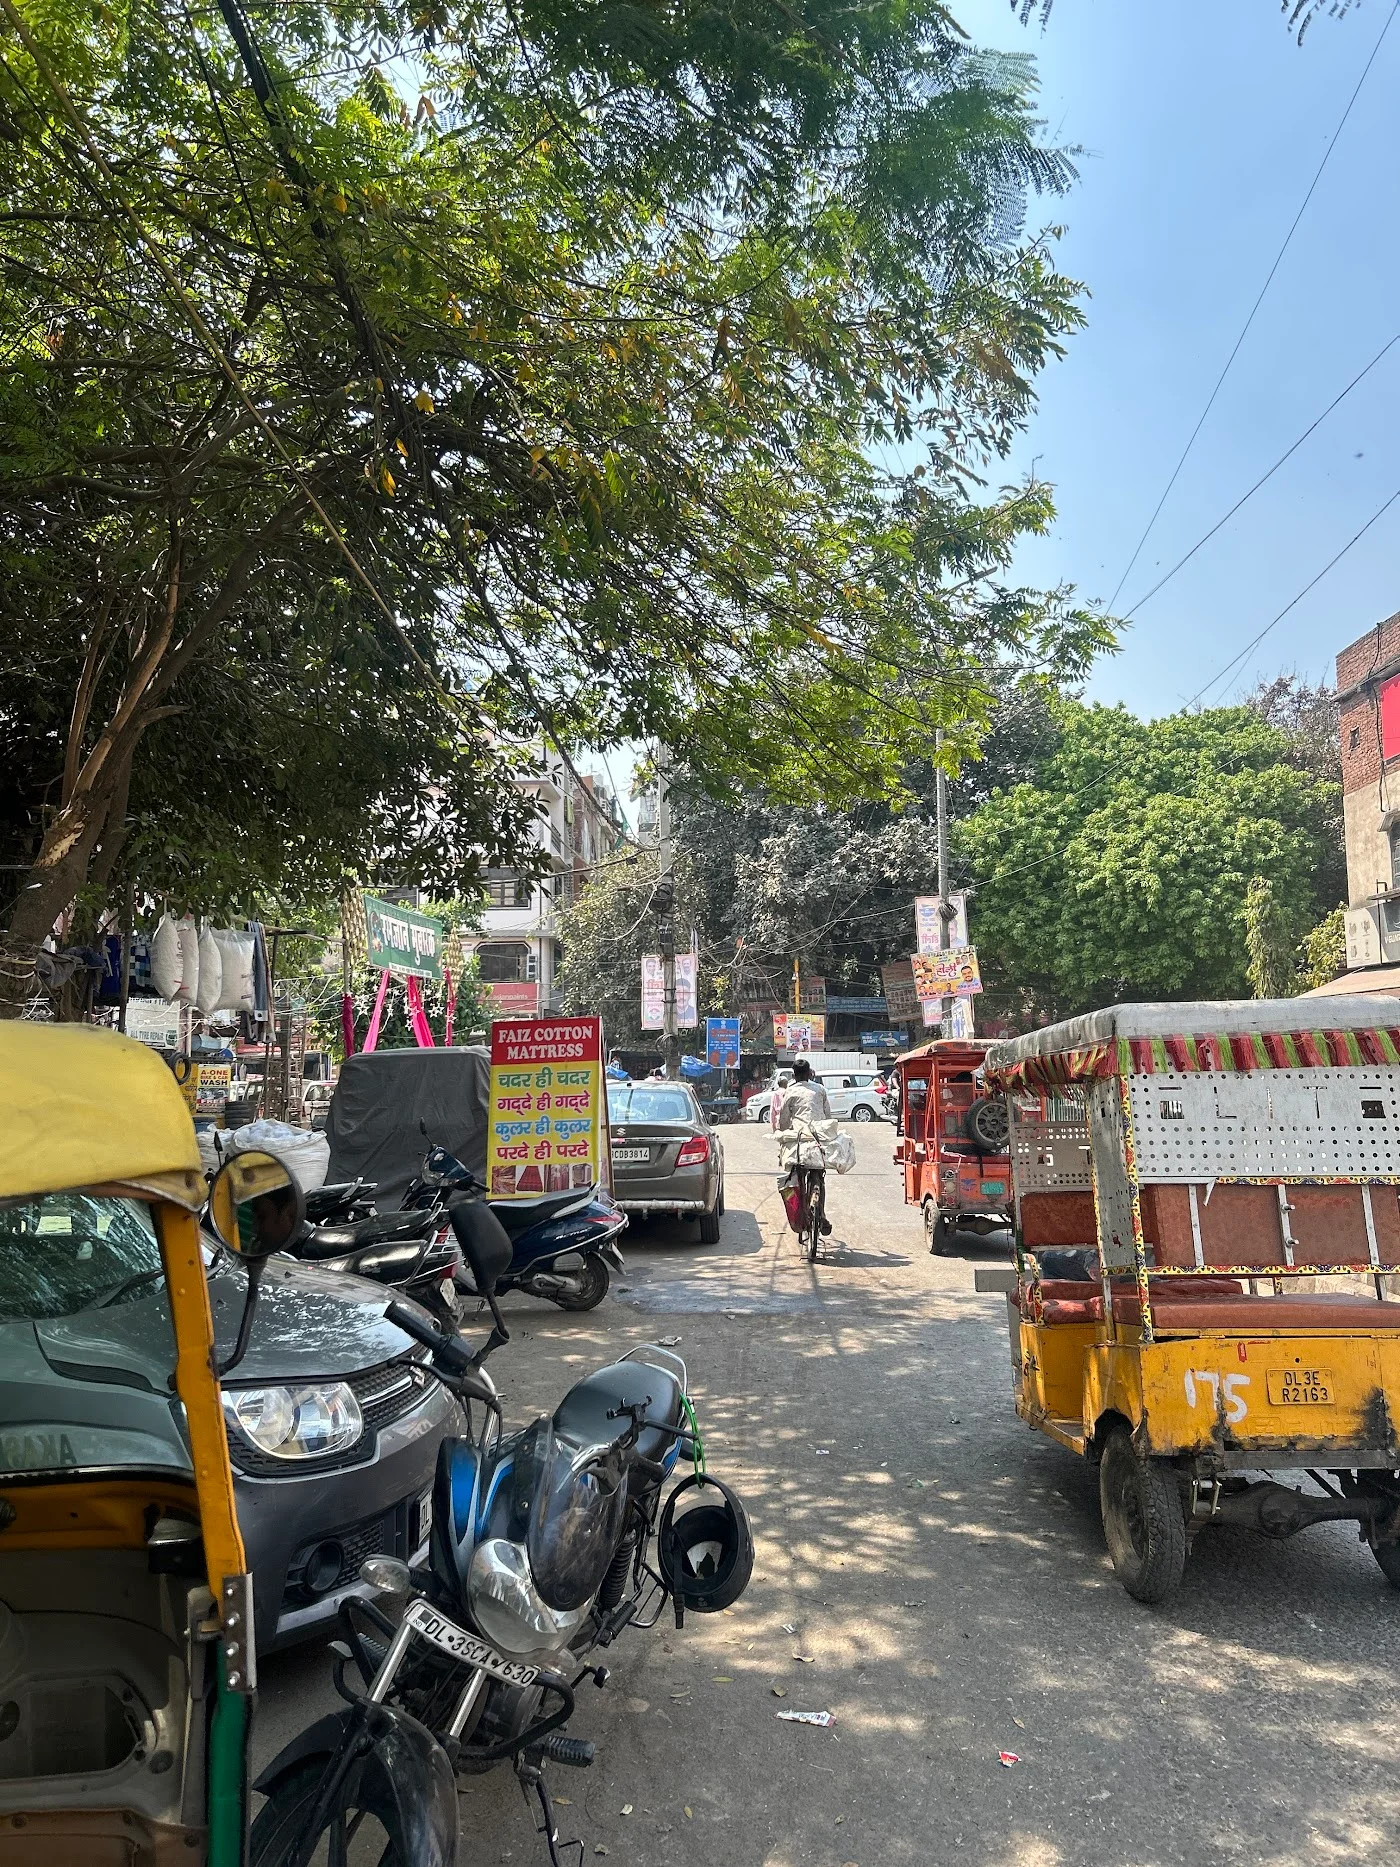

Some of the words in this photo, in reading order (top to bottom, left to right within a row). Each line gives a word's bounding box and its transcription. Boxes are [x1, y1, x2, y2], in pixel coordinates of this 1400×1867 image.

[498, 1029, 532, 1043] FAIZ
[534, 1026, 593, 1042] COTTON
[507, 1043, 584, 1060] MATTRESS
[498, 1073, 532, 1088] चदर
[535, 1066, 553, 1088] ही
[556, 1070, 591, 1086] चदर
[536, 1092, 552, 1111] ही
[495, 1121, 532, 1142] कुलर
[535, 1115, 551, 1135] ही
[554, 1119, 592, 1140] कुलर
[496, 1141, 530, 1160] परदे
[534, 1140, 552, 1160] ही
[556, 1139, 589, 1157] परदे
[1285, 1371, 1320, 1387] DL3E
[1184, 1368, 1250, 1423] 175
[1282, 1387, 1328, 1403] R2163
